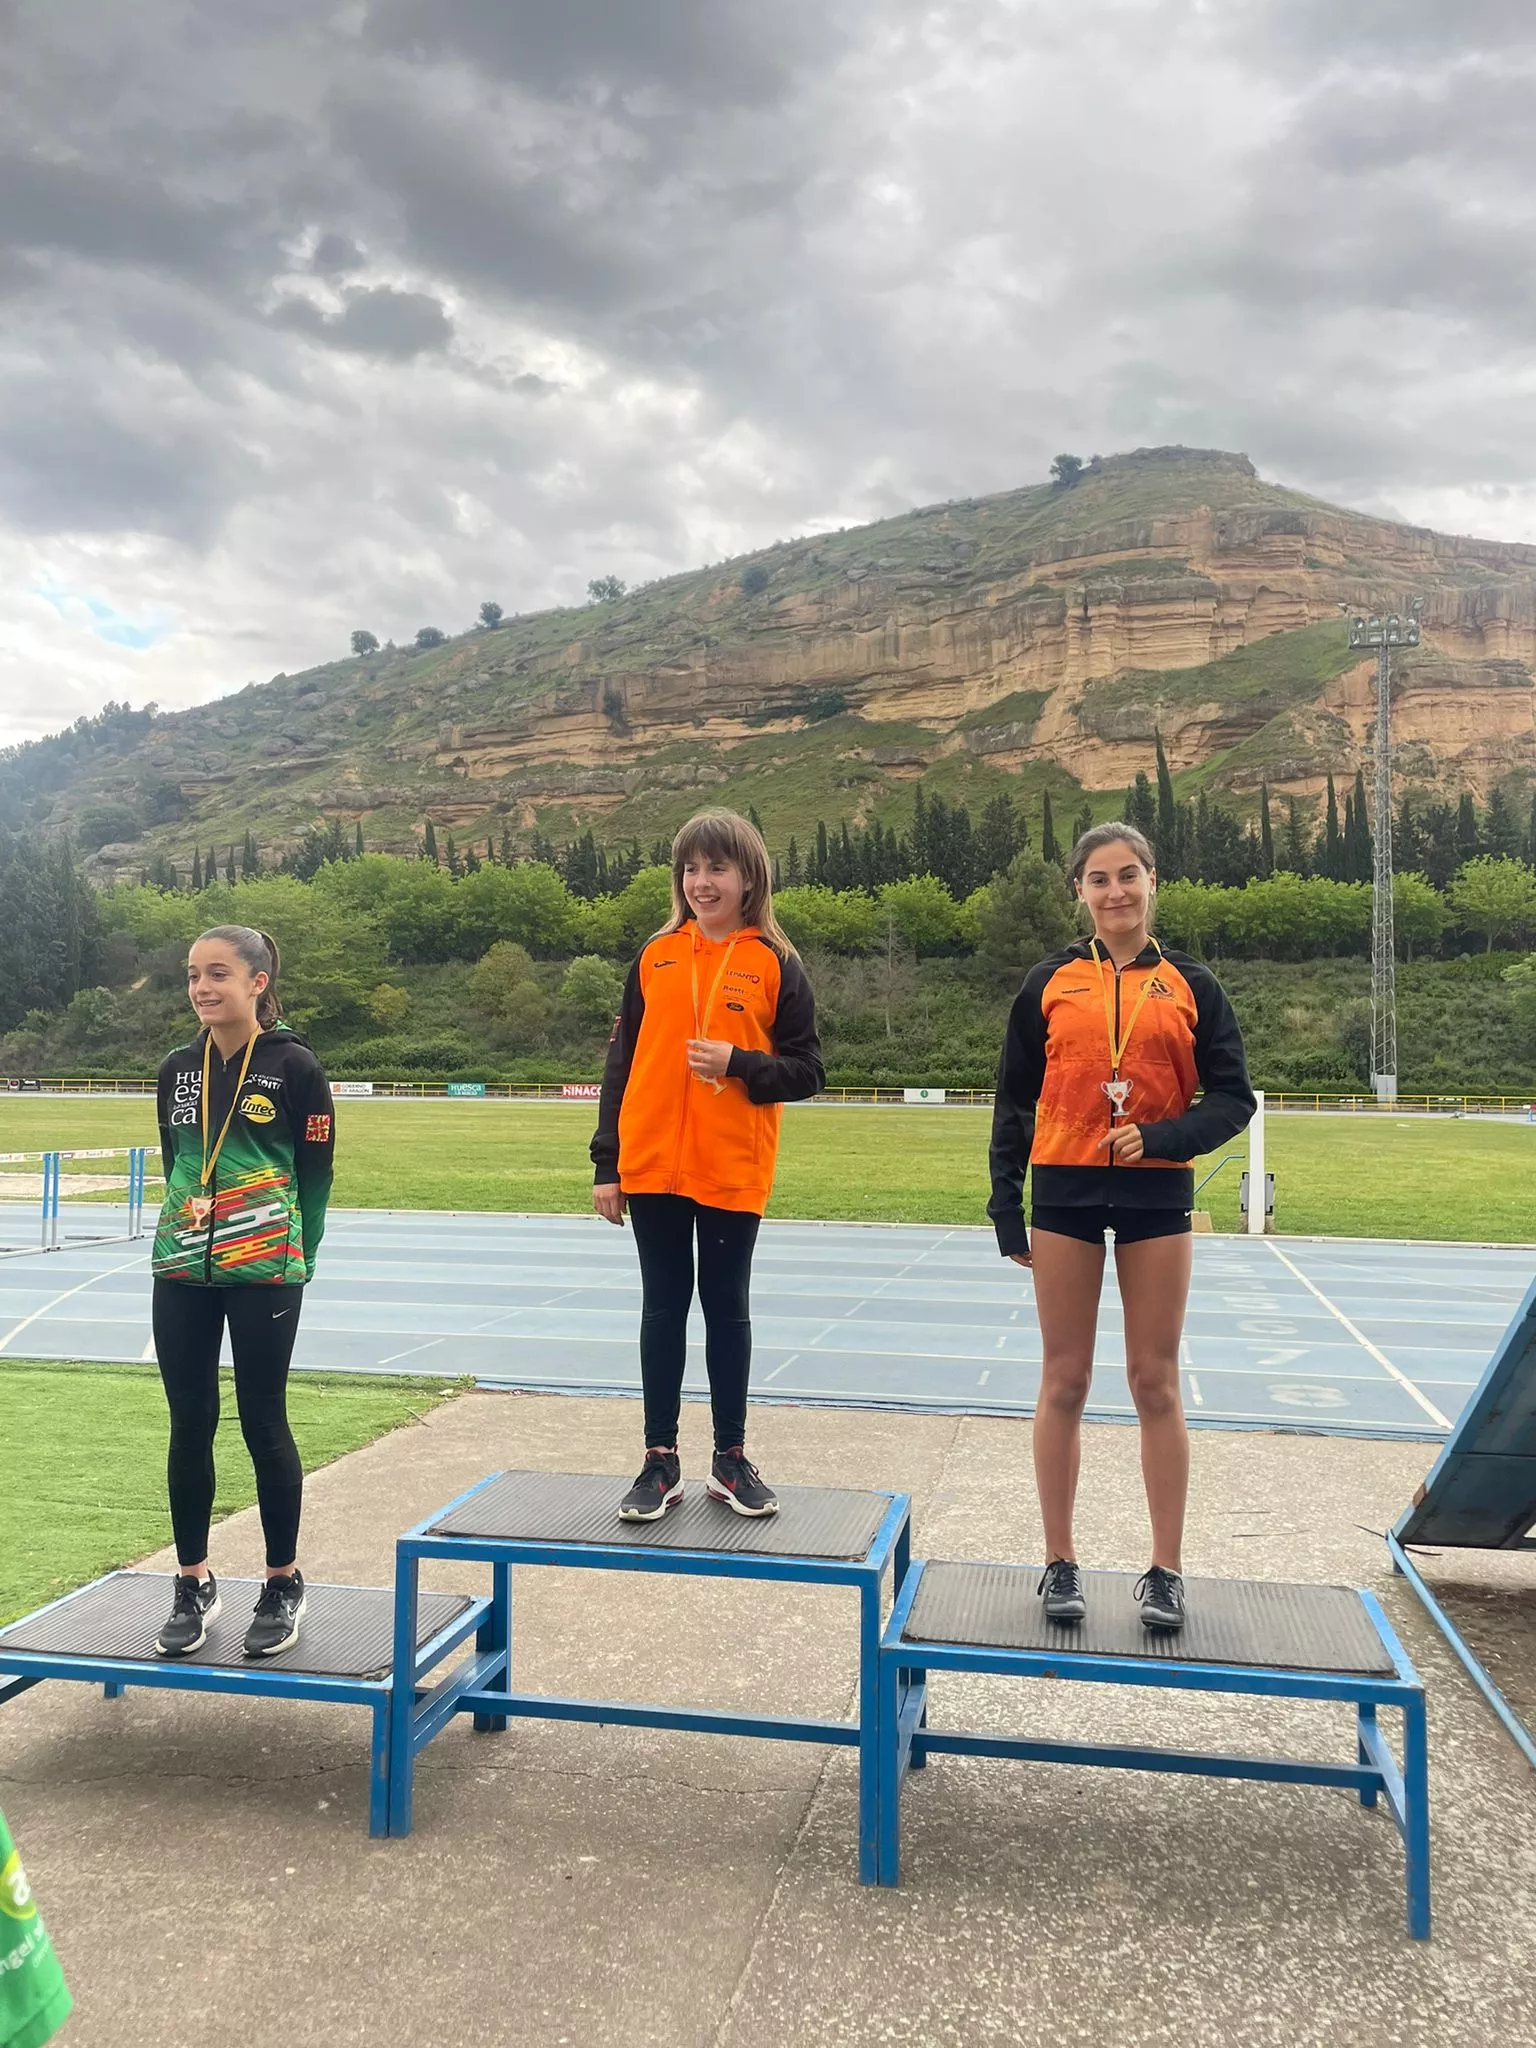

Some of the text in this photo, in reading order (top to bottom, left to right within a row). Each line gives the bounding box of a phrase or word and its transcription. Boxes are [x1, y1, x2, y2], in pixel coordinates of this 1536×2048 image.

[171, 1107, 198, 1126] ca
[1222, 1296, 1281, 1310] 5
[1236, 1319, 1299, 1335] 6
[1246, 1346, 1312, 1366] 7
[1266, 1383, 1352, 1408] 8
